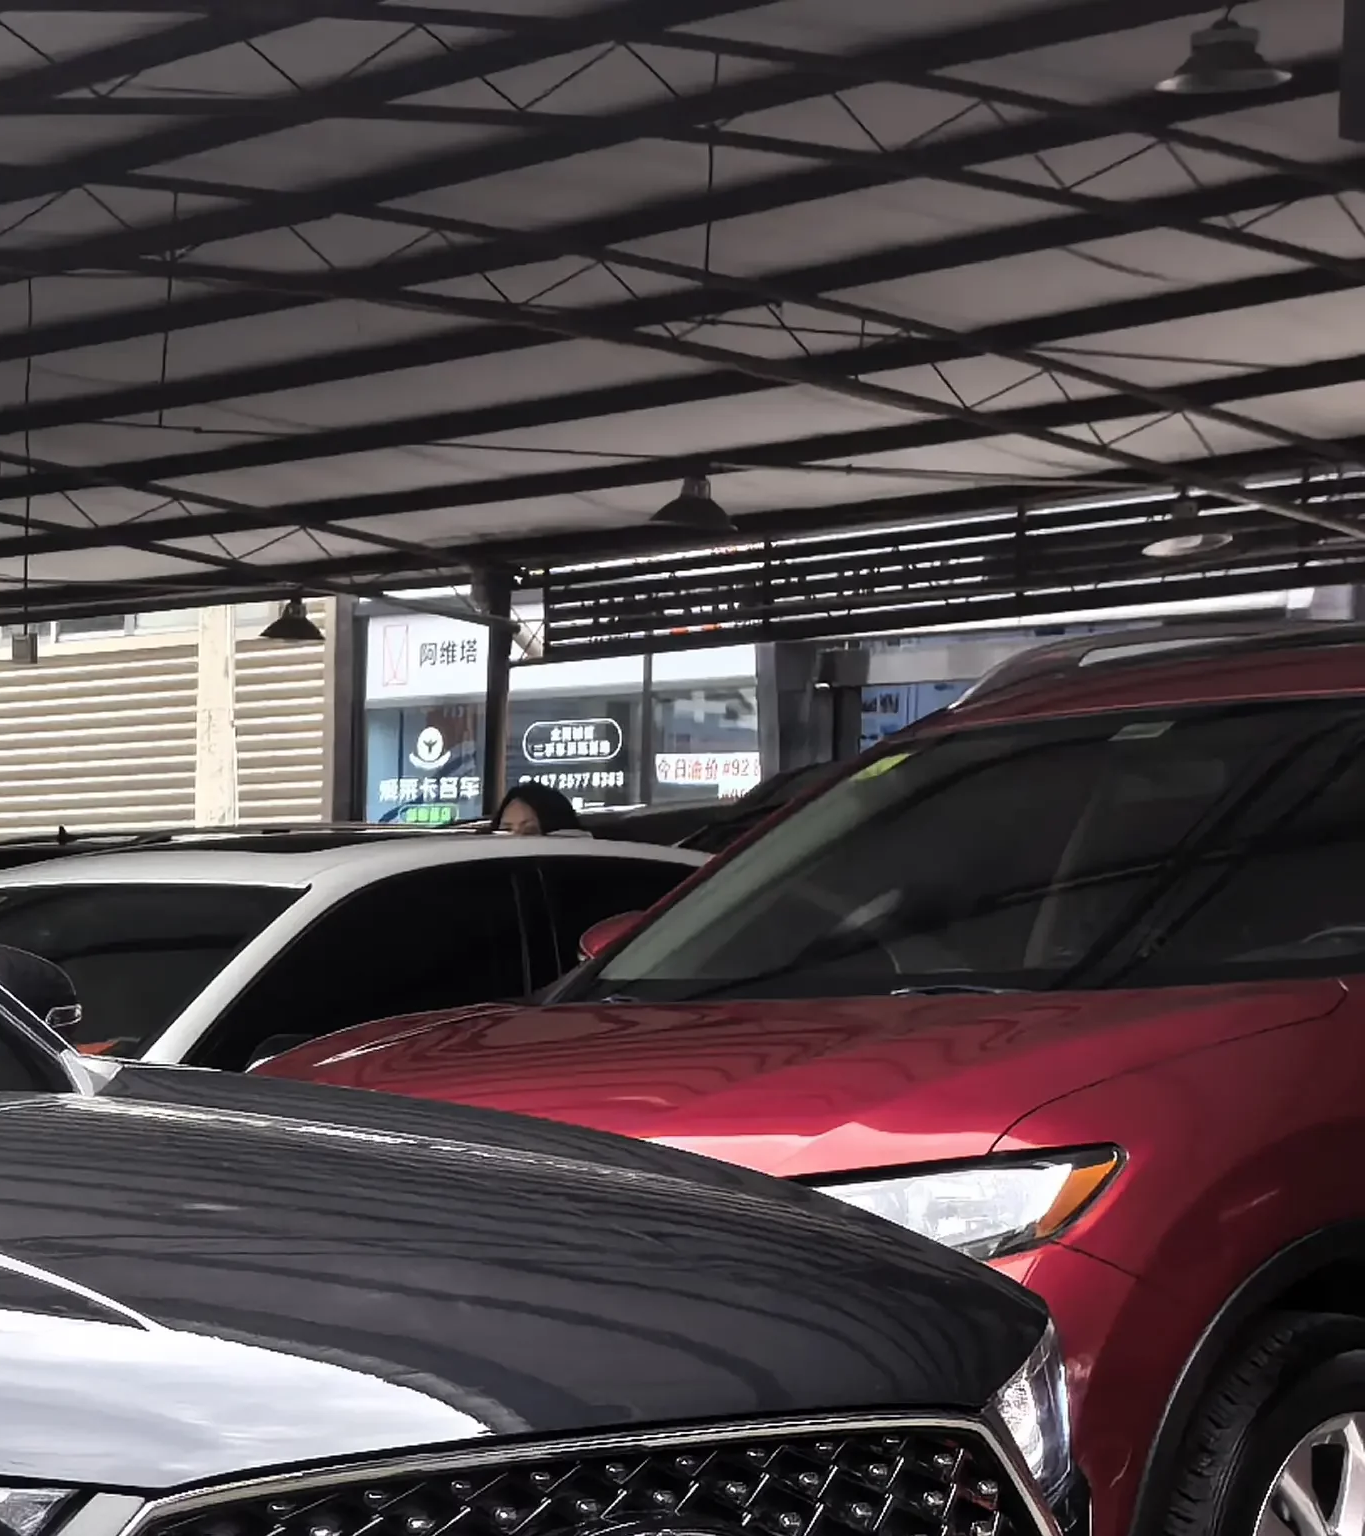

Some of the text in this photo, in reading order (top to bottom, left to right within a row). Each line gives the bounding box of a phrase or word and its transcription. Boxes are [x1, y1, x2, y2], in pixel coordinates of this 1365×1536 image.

[419, 639, 478, 667] 阿维塔
[657, 757, 718, 780] 今日油价
